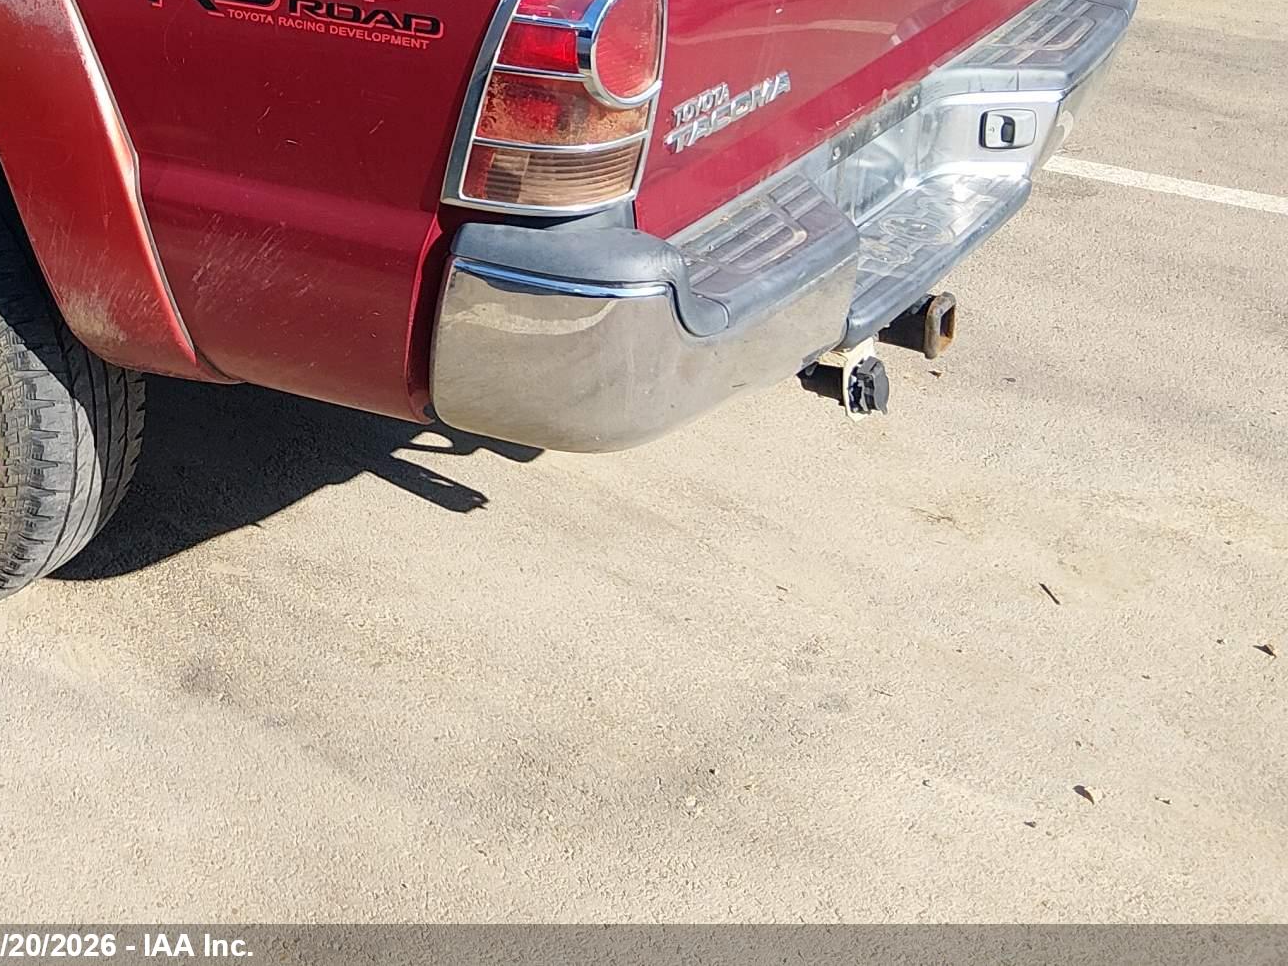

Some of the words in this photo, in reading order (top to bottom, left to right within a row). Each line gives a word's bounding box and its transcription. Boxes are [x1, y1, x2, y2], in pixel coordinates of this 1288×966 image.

[227, 8, 274, 25] TOYOTA
[278, 16, 325, 33] RACING
[329, 25, 430, 50] DEVELOPMENT
[664, 71, 791, 154] TACOMA
[672, 82, 730, 127] TOYOTA
